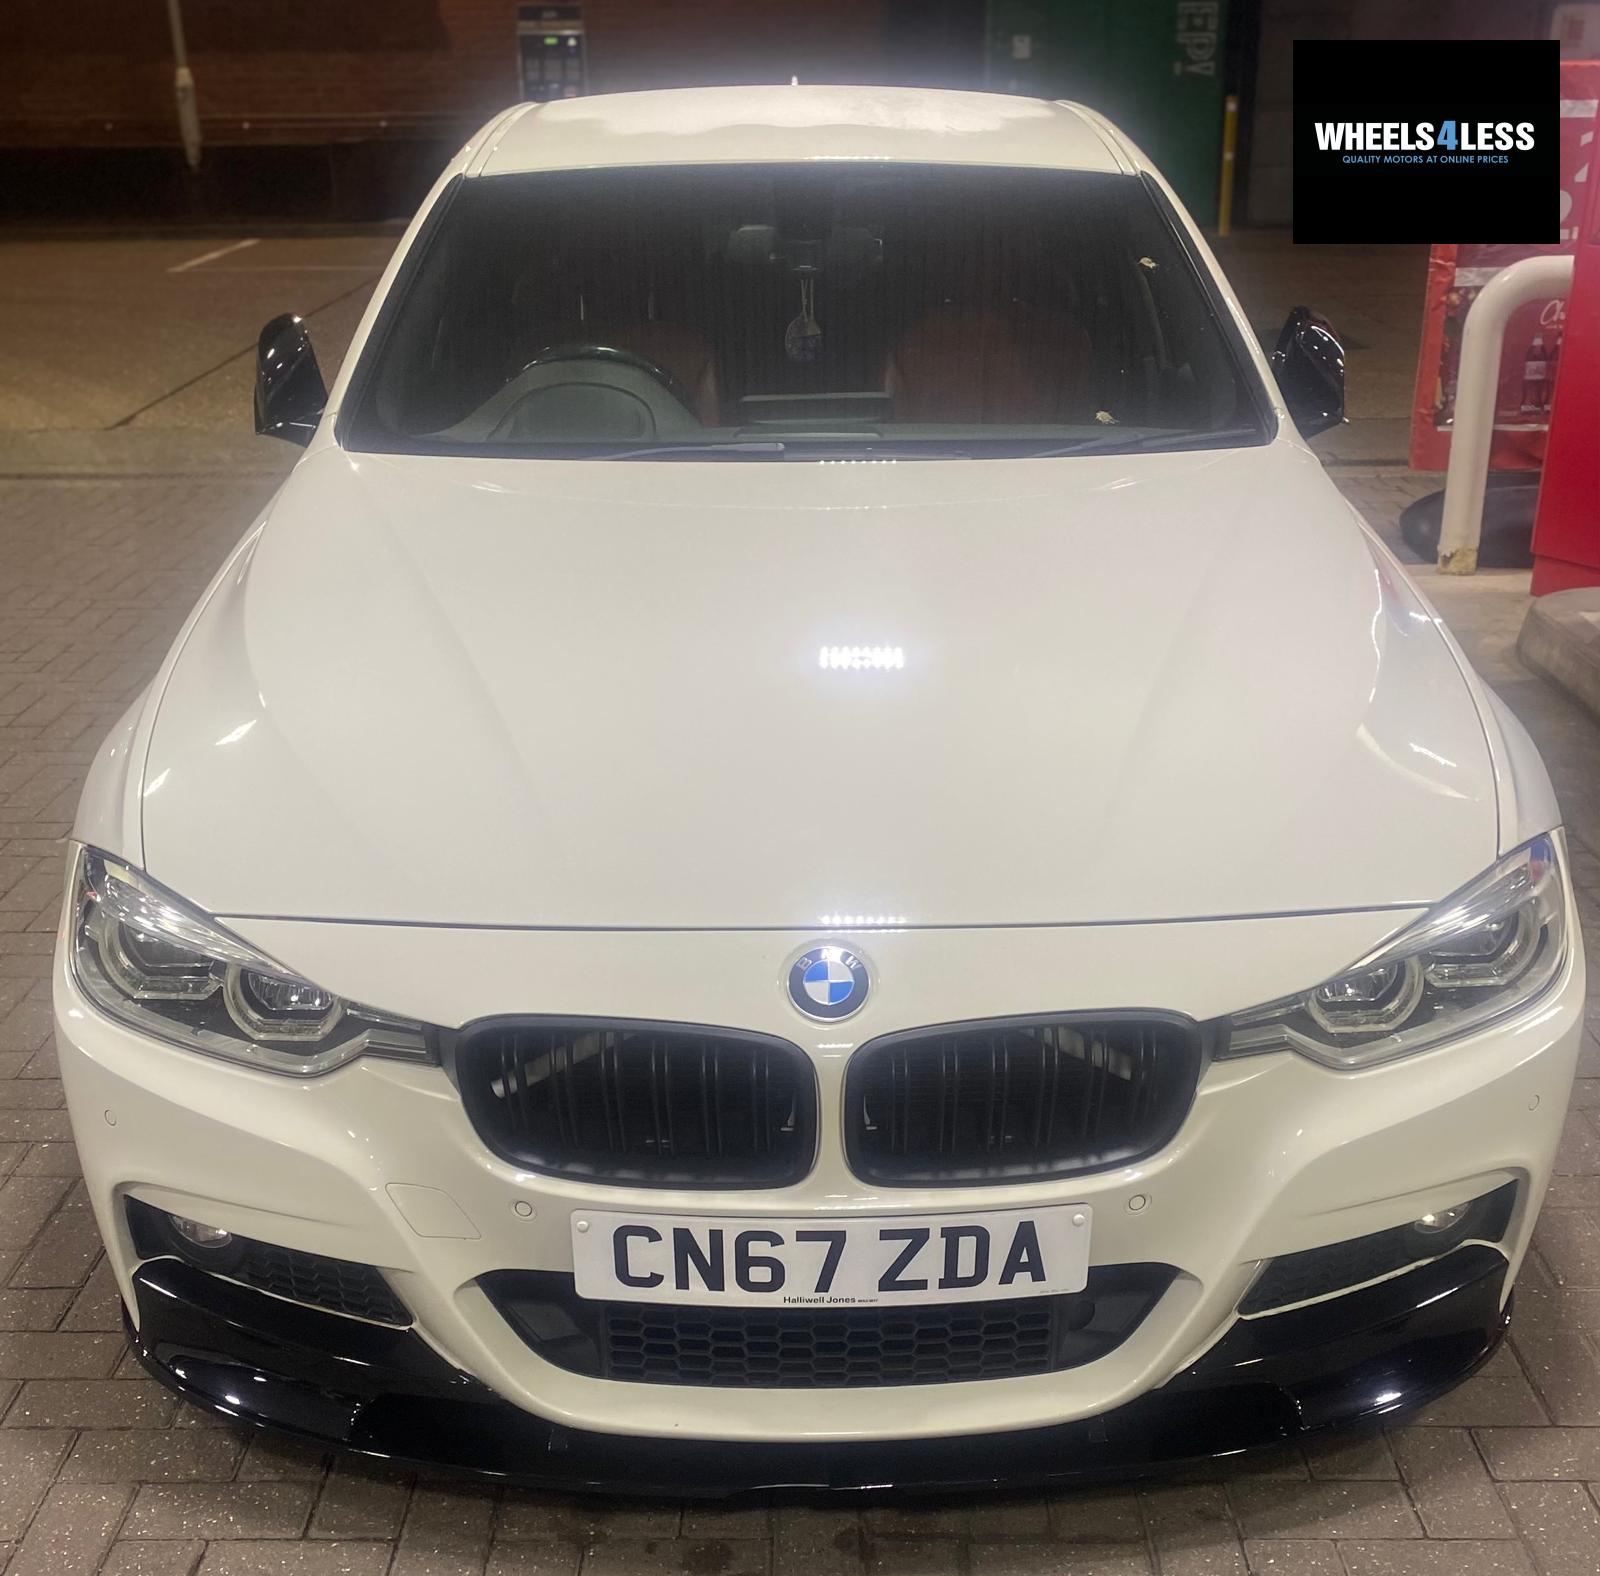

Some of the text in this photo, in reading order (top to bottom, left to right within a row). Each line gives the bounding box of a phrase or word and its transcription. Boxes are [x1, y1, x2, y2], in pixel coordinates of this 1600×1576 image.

[797, 949, 860, 970] BMW
[612, 1221, 1046, 1293] CN67 ZDA
[783, 1296, 825, 1304] Halliwell
[826, 1296, 856, 1304] Jones
